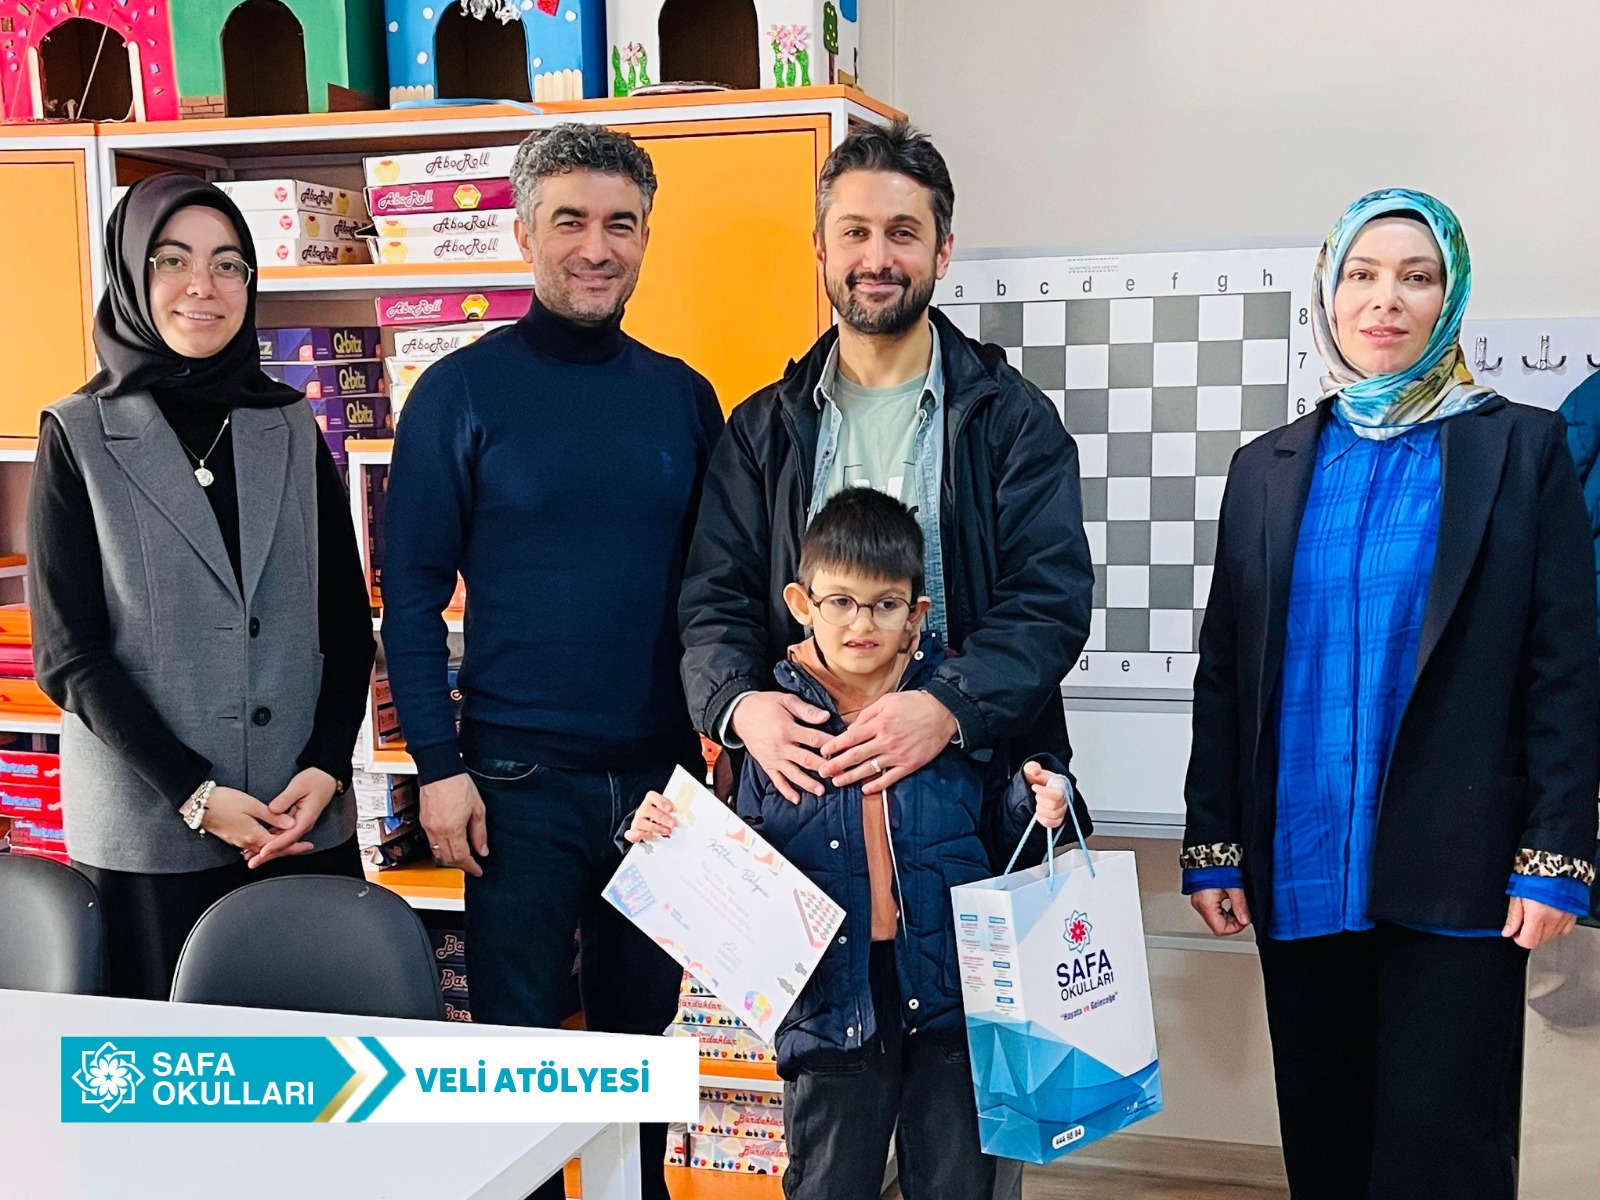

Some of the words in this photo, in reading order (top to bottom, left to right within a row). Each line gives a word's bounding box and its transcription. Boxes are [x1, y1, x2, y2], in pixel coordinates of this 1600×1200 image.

[425, 152, 490, 175] AboRoll
[300, 188, 334, 207] AboRoll
[378, 190, 434, 209] AboRoll
[433, 214, 498, 233] AboRoll
[302, 245, 339, 262] AboRoll
[434, 238, 498, 258] AboRoll
[955, 284, 963, 297] a
[997, 280, 1007, 297] b
[1040, 282, 1049, 294] c
[1082, 276, 1092, 293] d
[1126, 278, 1135, 291] e
[1172, 272, 1179, 289] f
[1217, 274, 1228, 292] g
[1263, 269, 1273, 286] h
[386, 299, 443, 318] AboRoll
[1298, 308, 1309, 325] 8
[401, 337, 460, 354] AboRoll
[1298, 353, 1307, 369] 7
[1296, 398, 1306, 415] 6
[1080, 656, 1089, 671] d
[1121, 660, 1130, 672] e
[1166, 657, 1172, 673] f
[1056, 949, 1112, 987] SAFA
[1061, 971, 1114, 1001] OKULLARI
[679, 999, 722, 1010] ardaklar
